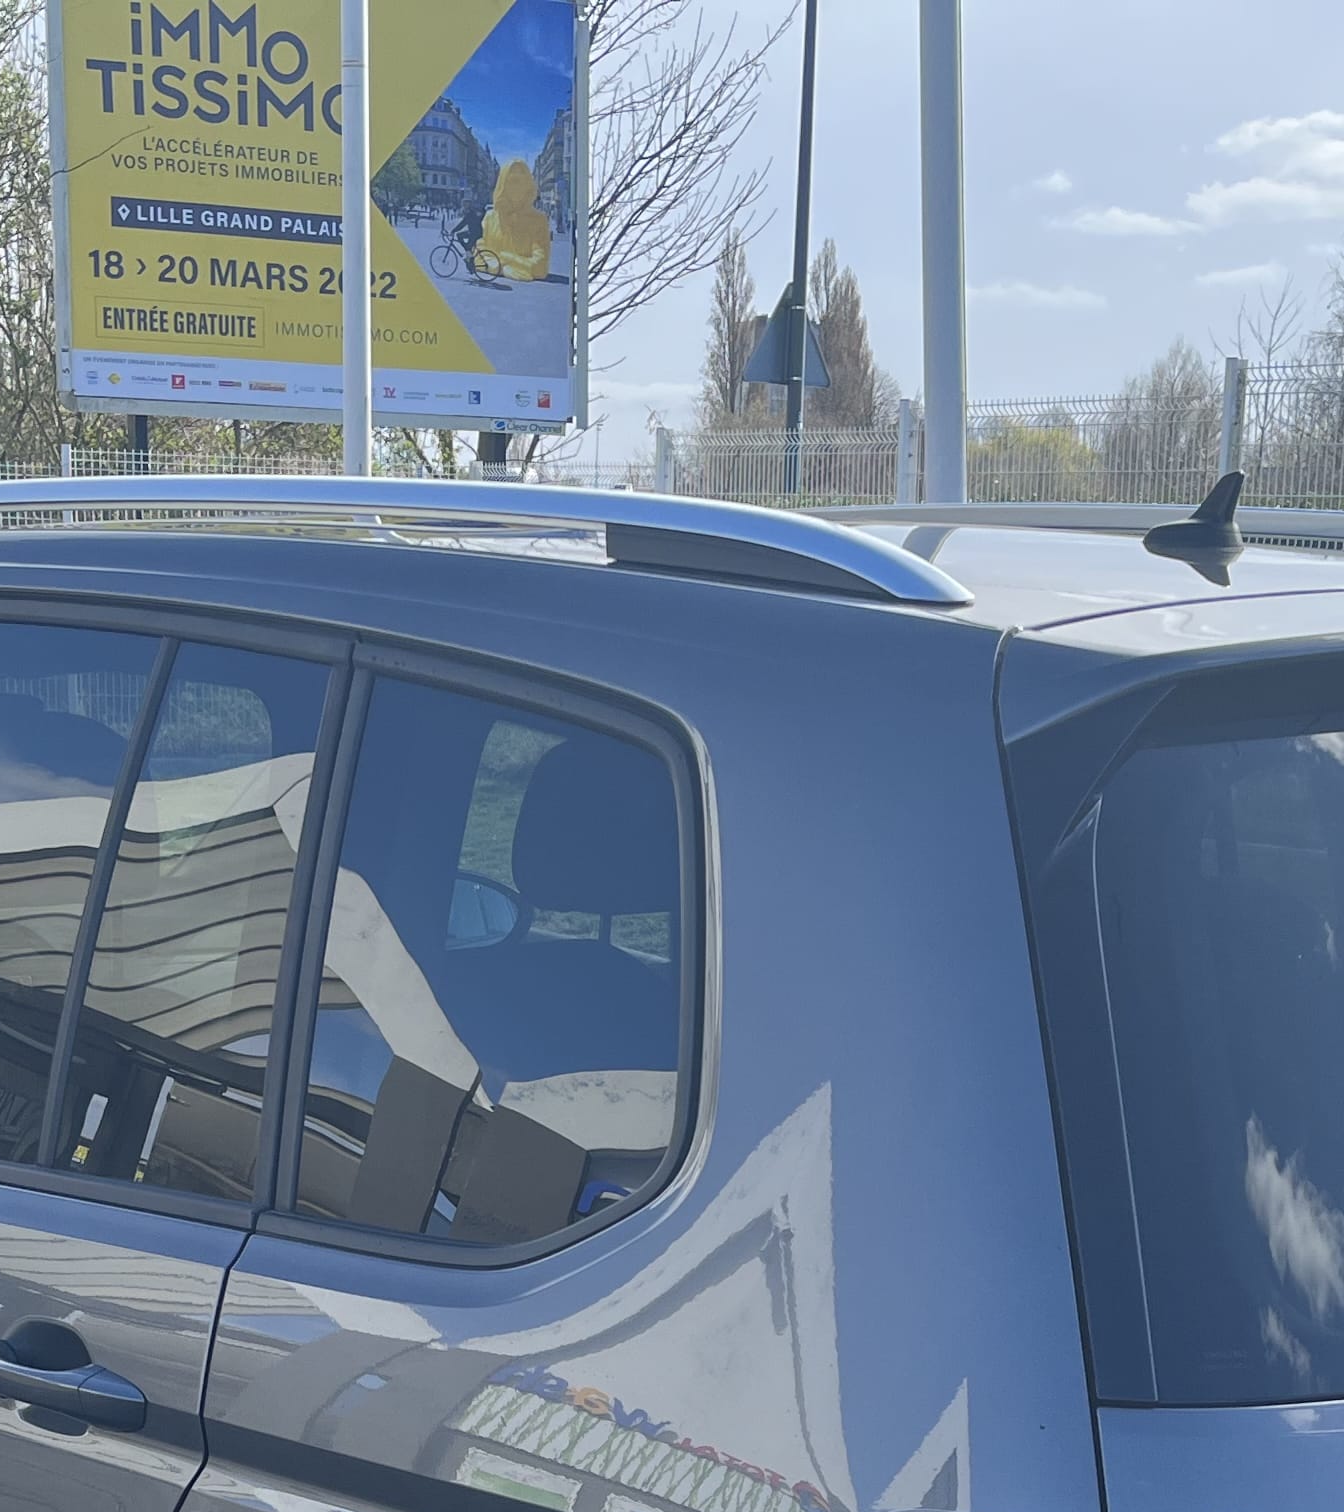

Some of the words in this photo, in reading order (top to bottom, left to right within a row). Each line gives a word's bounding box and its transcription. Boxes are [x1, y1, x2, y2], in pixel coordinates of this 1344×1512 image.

[143, 136, 290, 164] L'ACCÉLÉRATEUR
[297, 151, 319, 166] DE
[111, 154, 148, 170] VOS
[154, 159, 229, 178] PROJETS
[136, 205, 194, 225] LILLE
[200, 210, 273, 232] GRAND
[88, 250, 124, 279] 18
[157, 254, 199, 285] 20
[210, 258, 308, 293] MARS
[319, 267, 397, 300] 22
[102, 306, 169, 333] ENTRÉE
[174, 312, 256, 338] GRATUITE
[275, 321, 438, 345] IMMOTIMO.COM
